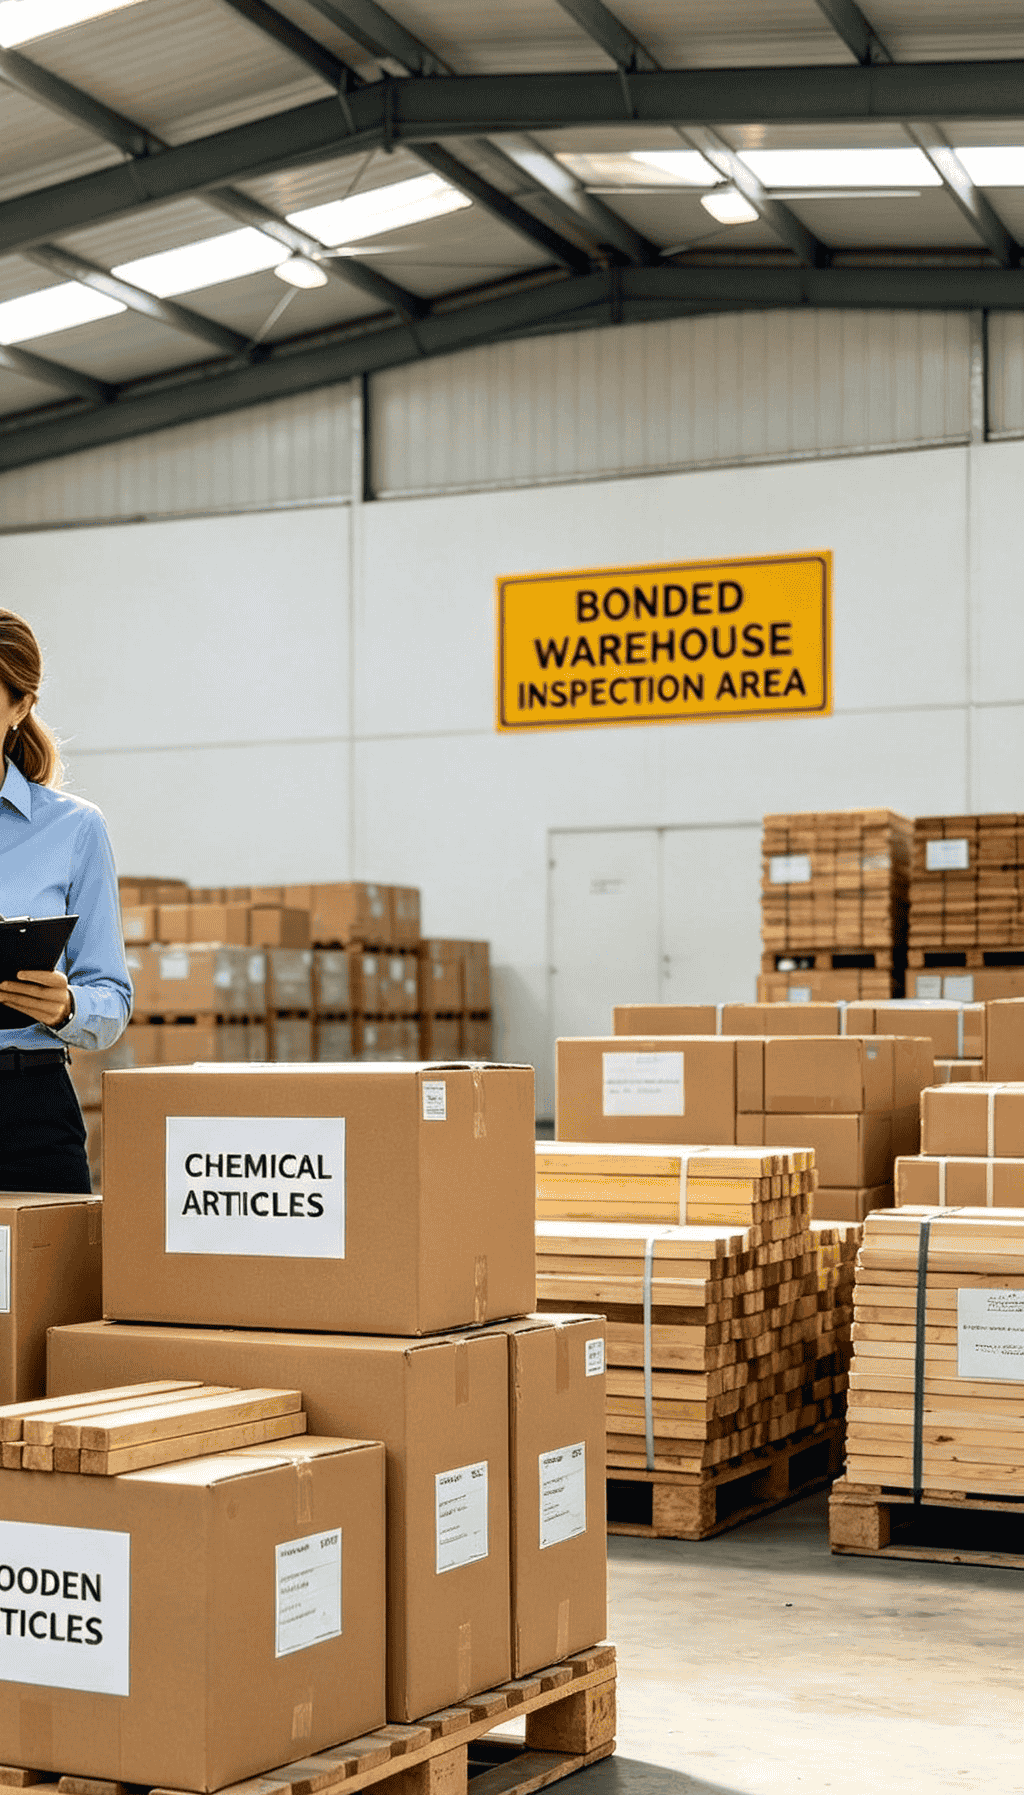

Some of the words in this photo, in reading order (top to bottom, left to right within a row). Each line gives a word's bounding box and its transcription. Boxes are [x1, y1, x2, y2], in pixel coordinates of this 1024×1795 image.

[577, 581, 744, 623] BONDED
[534, 622, 792, 669] WAREHOUSE
[518, 674, 705, 709] INSPECTION
[716, 668, 807, 701] AREA
[184, 1153, 332, 1179] CHEMICAL
[181, 1190, 324, 1217] ARTICLES
